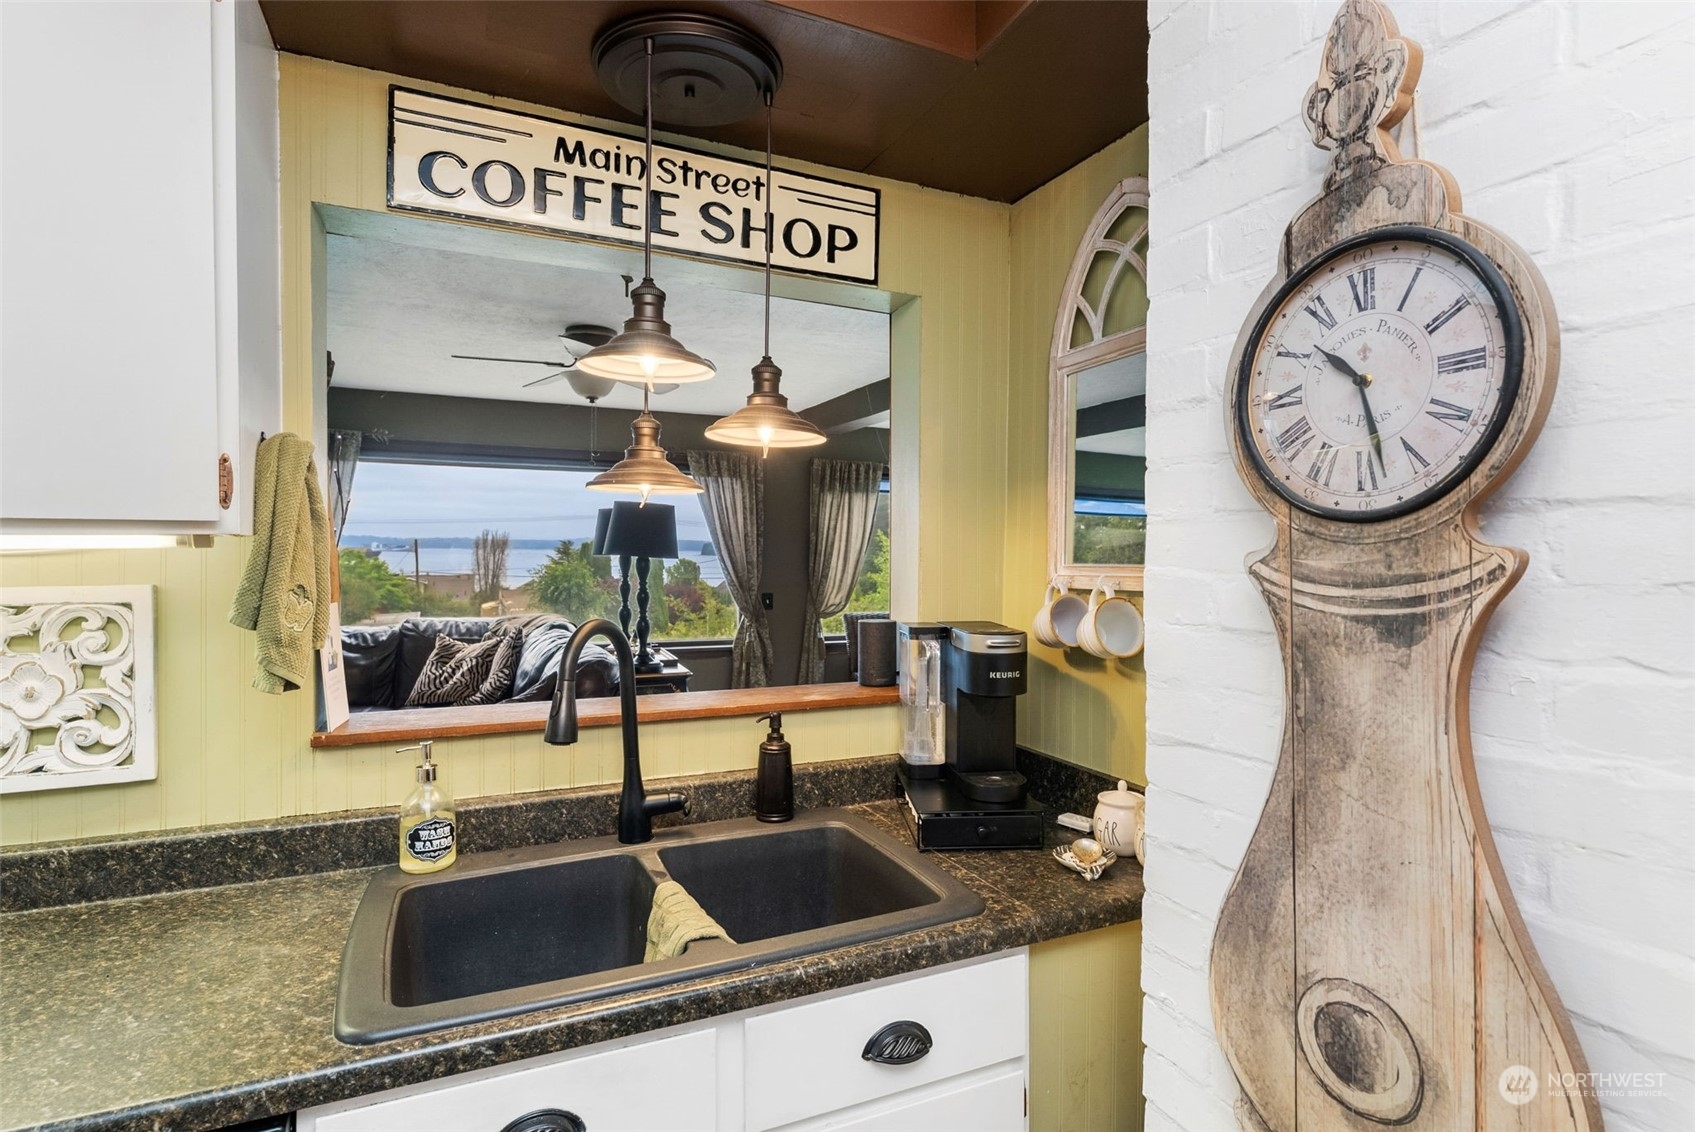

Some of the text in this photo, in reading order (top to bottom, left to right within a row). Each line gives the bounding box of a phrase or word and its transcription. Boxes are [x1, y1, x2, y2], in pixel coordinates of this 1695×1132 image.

[554, 137, 767, 202] Main Street
[417, 150, 859, 263] COFFEE SHOP
[1353, 248, 1373, 263] 60
[1421, 245, 1432, 258] 5
[1347, 267, 1376, 316] XII
[1397, 267, 1423, 312] I
[1304, 293, 1338, 338] XI
[1423, 293, 1471, 336] II
[1276, 343, 1313, 370] X
[1314, 319, 1418, 376] JQUES PANIER
[1437, 346, 1487, 374] III
[1268, 384, 1303, 412] IX
[1425, 397, 1473, 433] IV
[1355, 410, 1391, 428] PRIS
[1276, 416, 1317, 463] VIII
[1400, 436, 1431, 475] V
[1306, 441, 1339, 487] VII
[1356, 450, 1379, 492] VI
[989, 670, 1020, 679] KEURIG
[414, 835, 453, 852] HANDS
[418, 825, 451, 841] WASH
